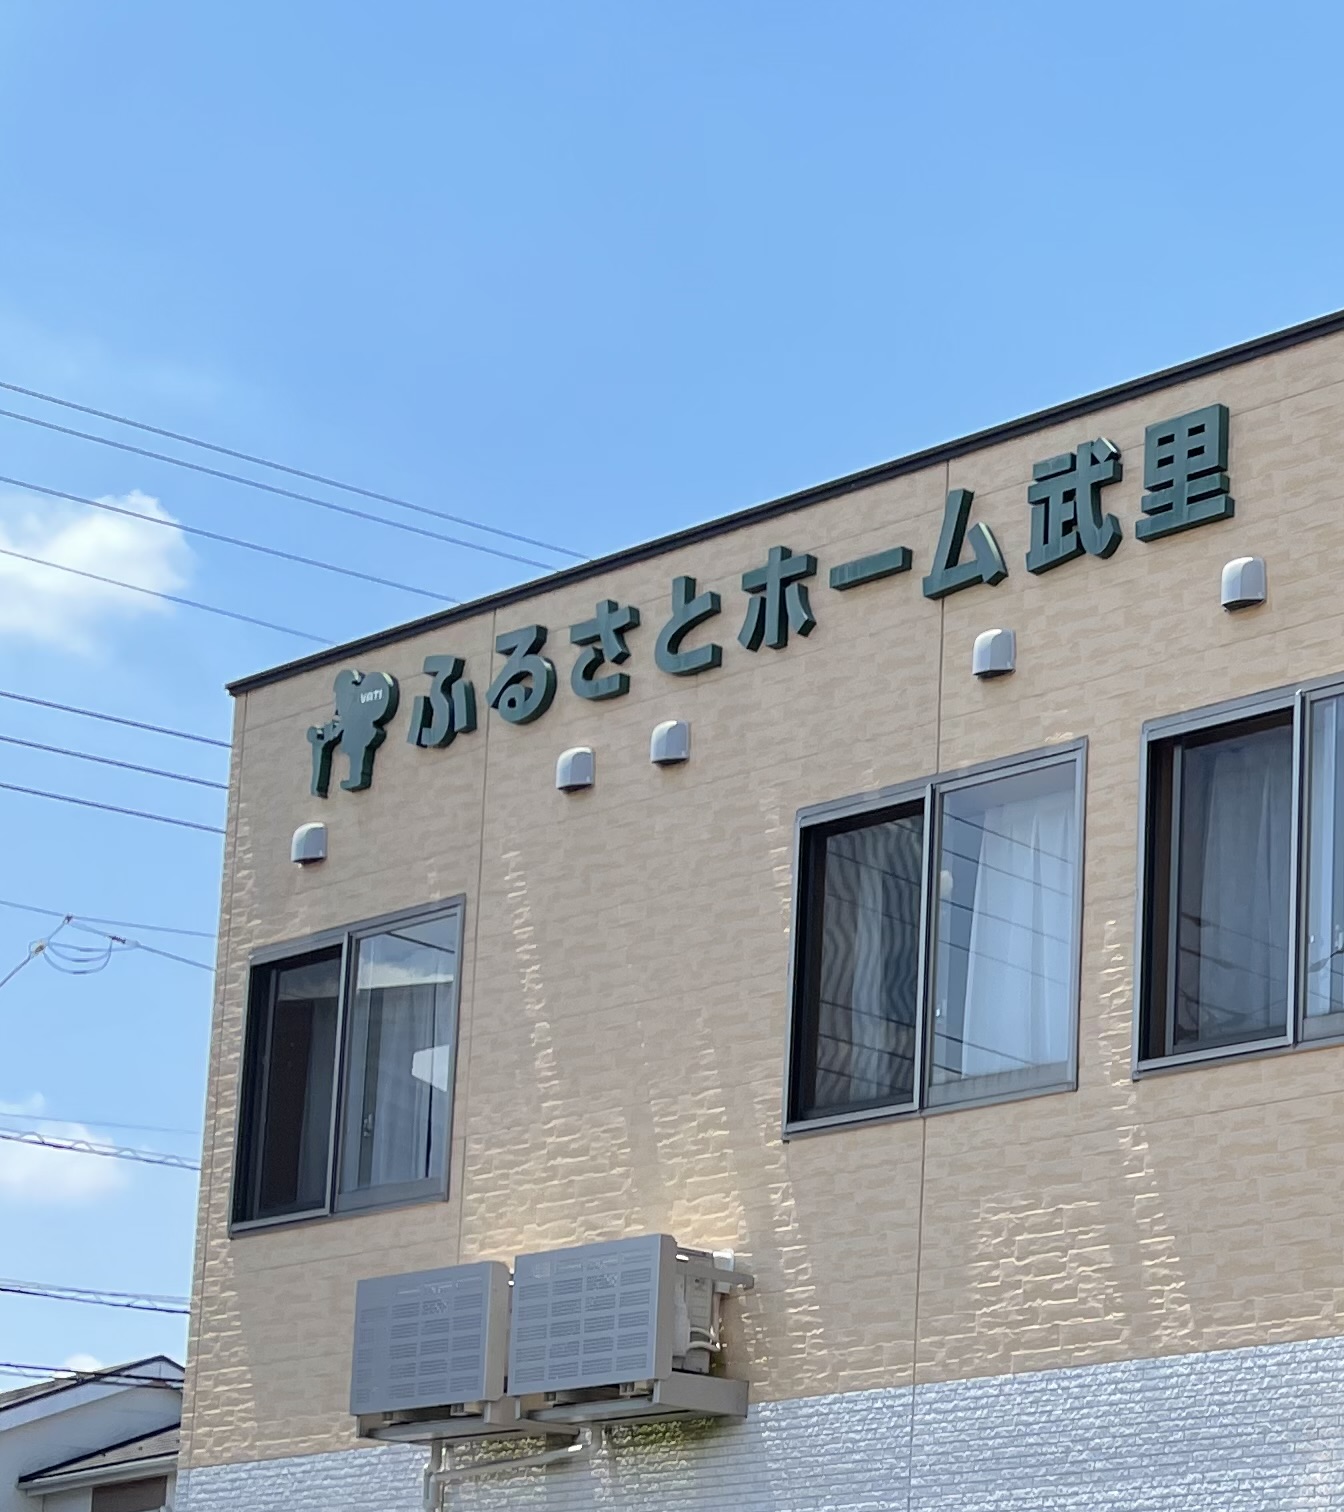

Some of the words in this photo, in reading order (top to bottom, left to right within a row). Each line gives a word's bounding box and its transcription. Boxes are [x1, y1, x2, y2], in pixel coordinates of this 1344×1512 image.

[406, 402, 1235, 750] ふるさとホーム武里
